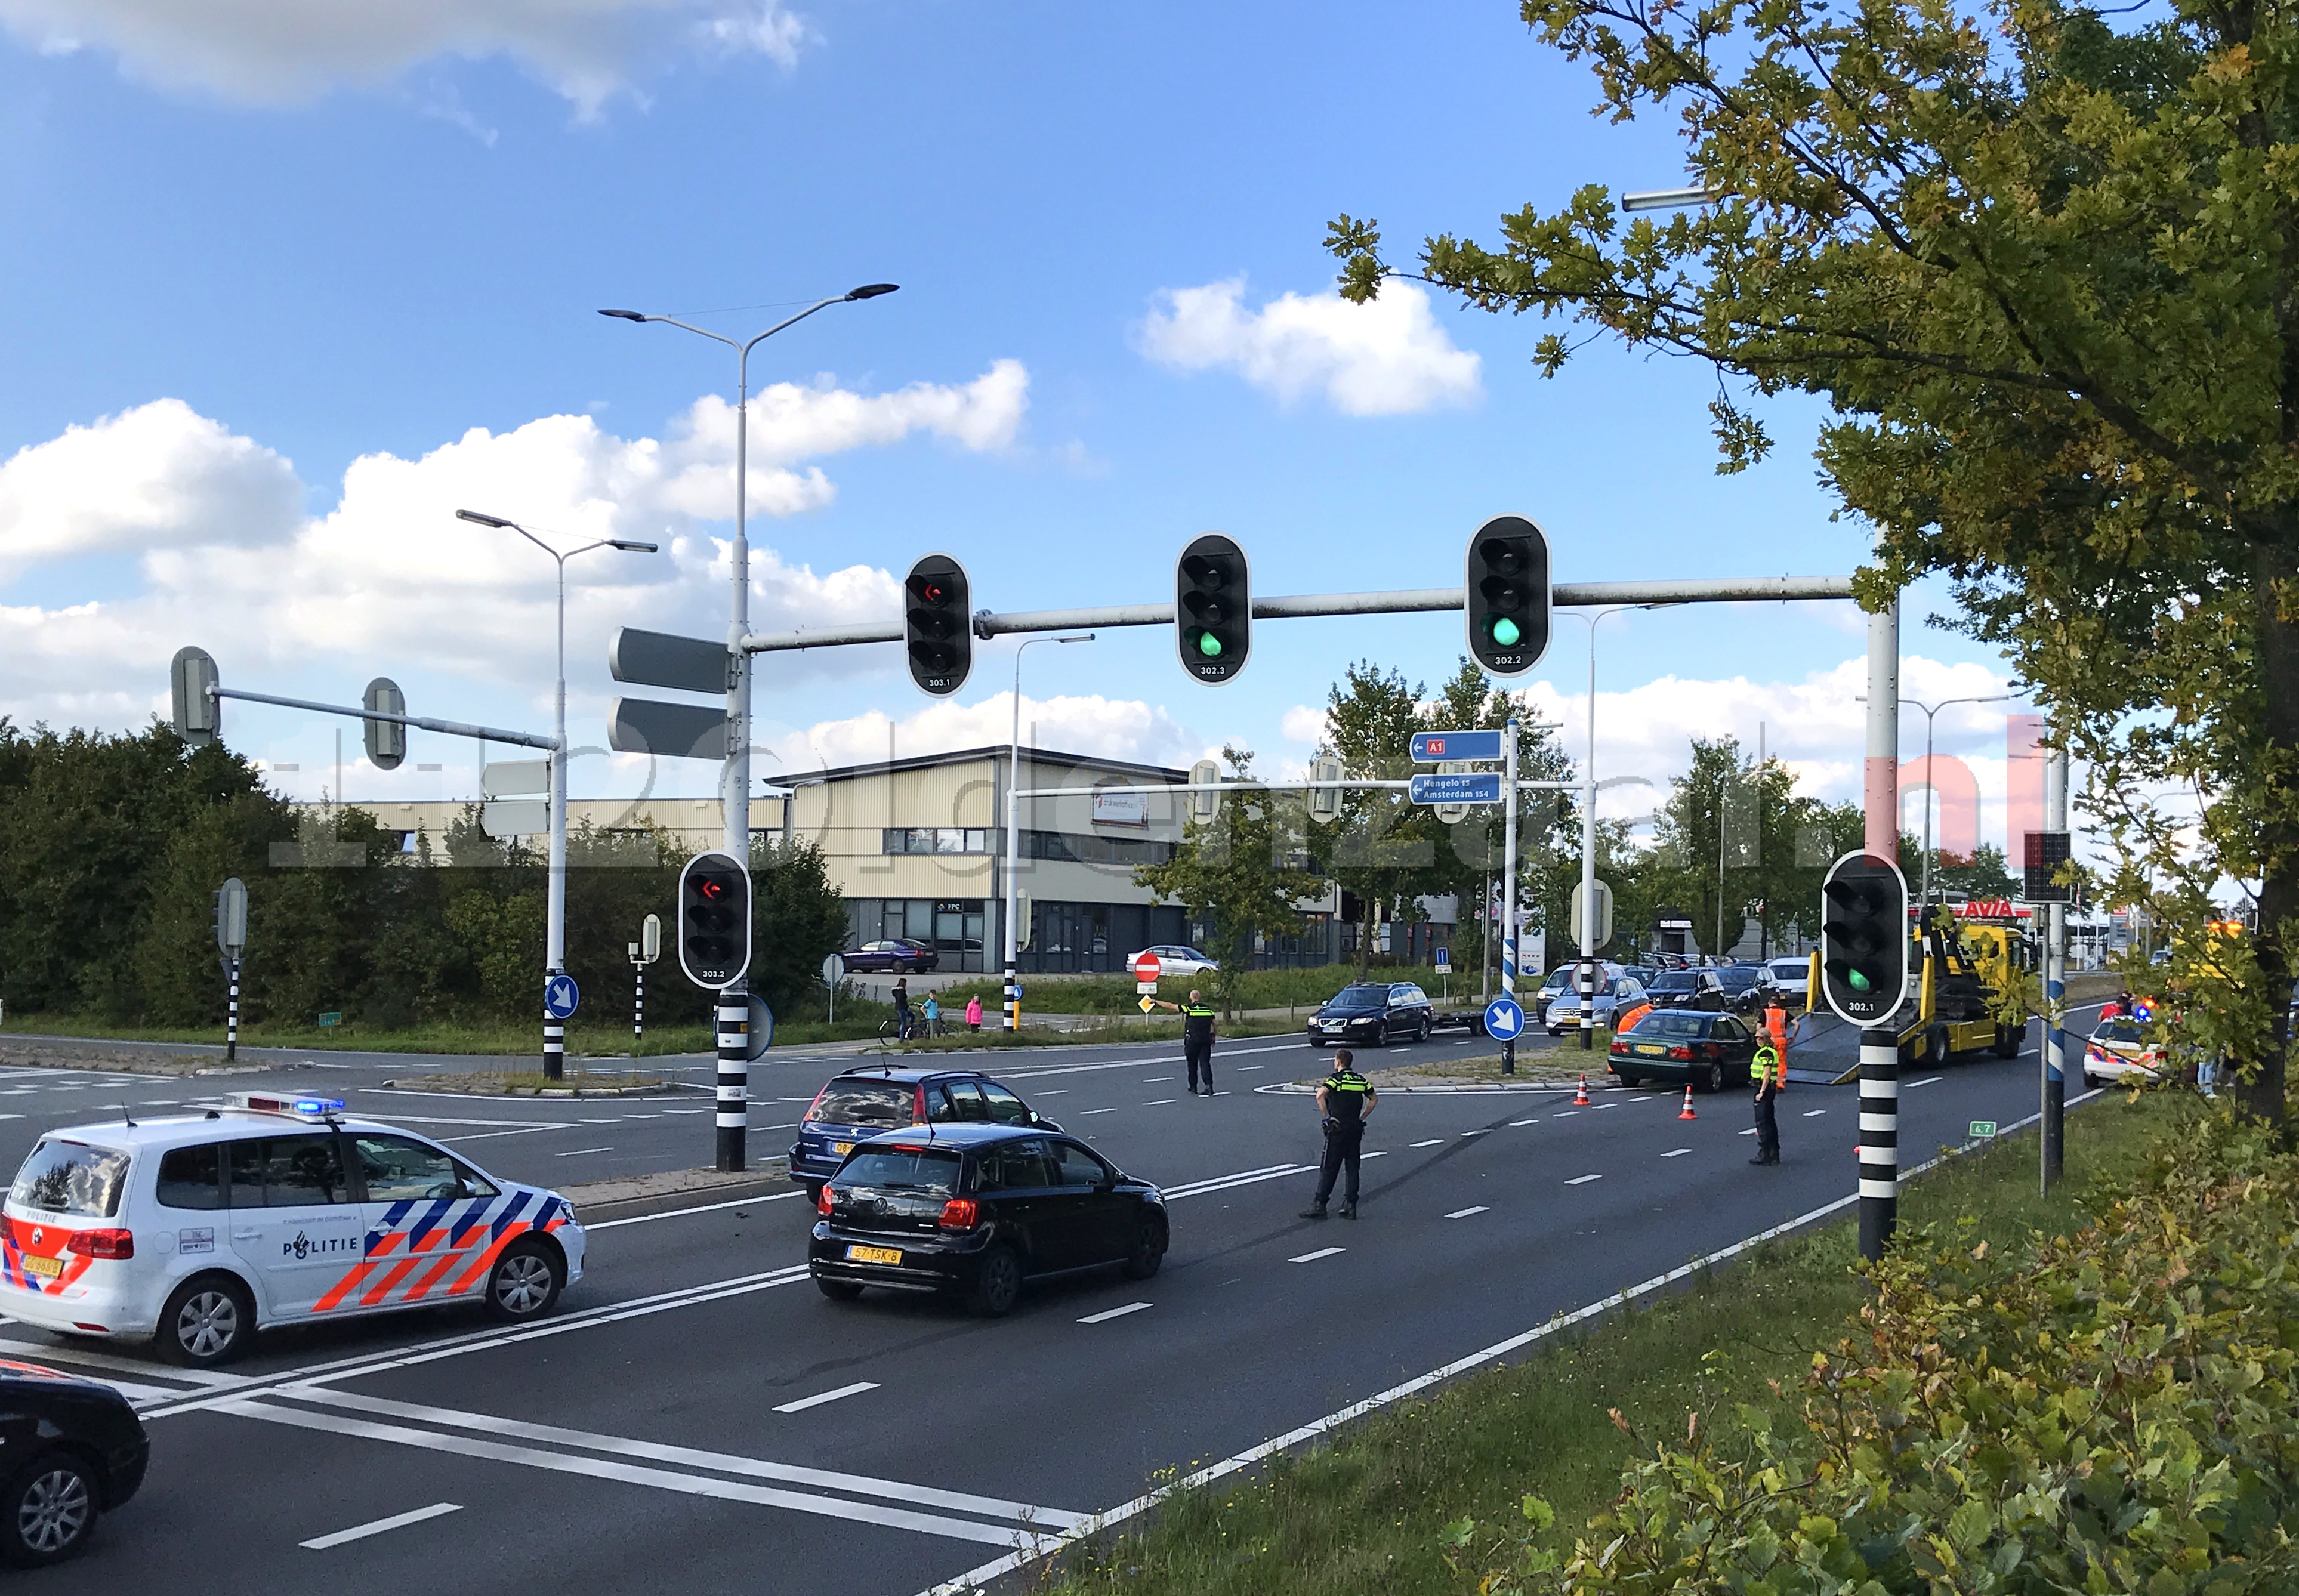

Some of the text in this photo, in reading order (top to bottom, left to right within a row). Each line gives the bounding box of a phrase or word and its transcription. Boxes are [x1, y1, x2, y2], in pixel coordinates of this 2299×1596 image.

[1495, 656, 1522, 665] 302.2
[1200, 666, 1225, 675] 302.3
[929, 678, 951, 687] 303.1
[1430, 742, 1442, 752] A1
[1424, 779, 1459, 789] Hengelo
[1424, 790, 1473, 799] Amsterdam
[1963, 899, 2014, 917] AVIA
[1849, 1002, 1874, 1011] 302.1
[26, 1209, 57, 1224] POLITIE
[283, 1234, 357, 1259] POLITIE
[854, 1247, 898, 1261] 57-TSK-8
